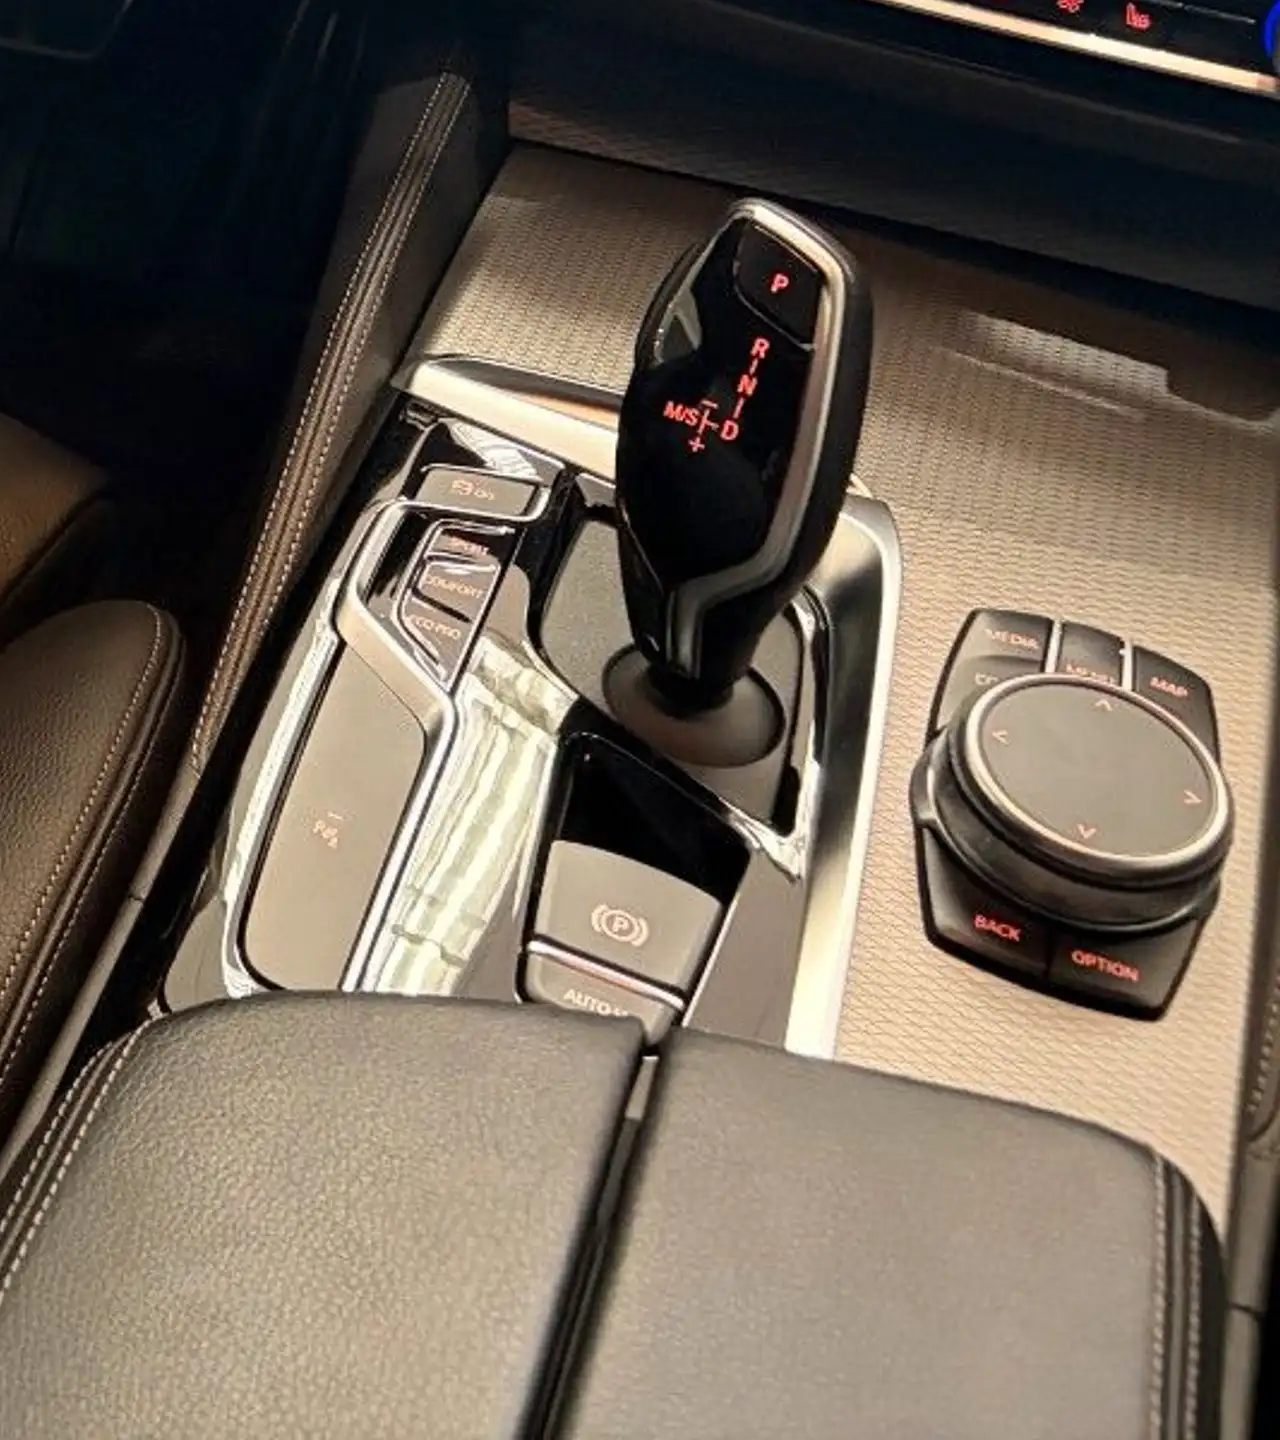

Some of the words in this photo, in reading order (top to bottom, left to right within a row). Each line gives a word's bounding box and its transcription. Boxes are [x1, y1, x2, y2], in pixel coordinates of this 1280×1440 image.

[770, 273, 790, 294] P
[751, 338, 770, 359] R
[736, 373, 759, 397] N
[719, 419, 740, 441] D
[1149, 675, 1189, 698] MAP
[974, 913, 1022, 943] BACK
[1071, 948, 1140, 983] OPTION
[563, 988, 613, 1017] AUTO
